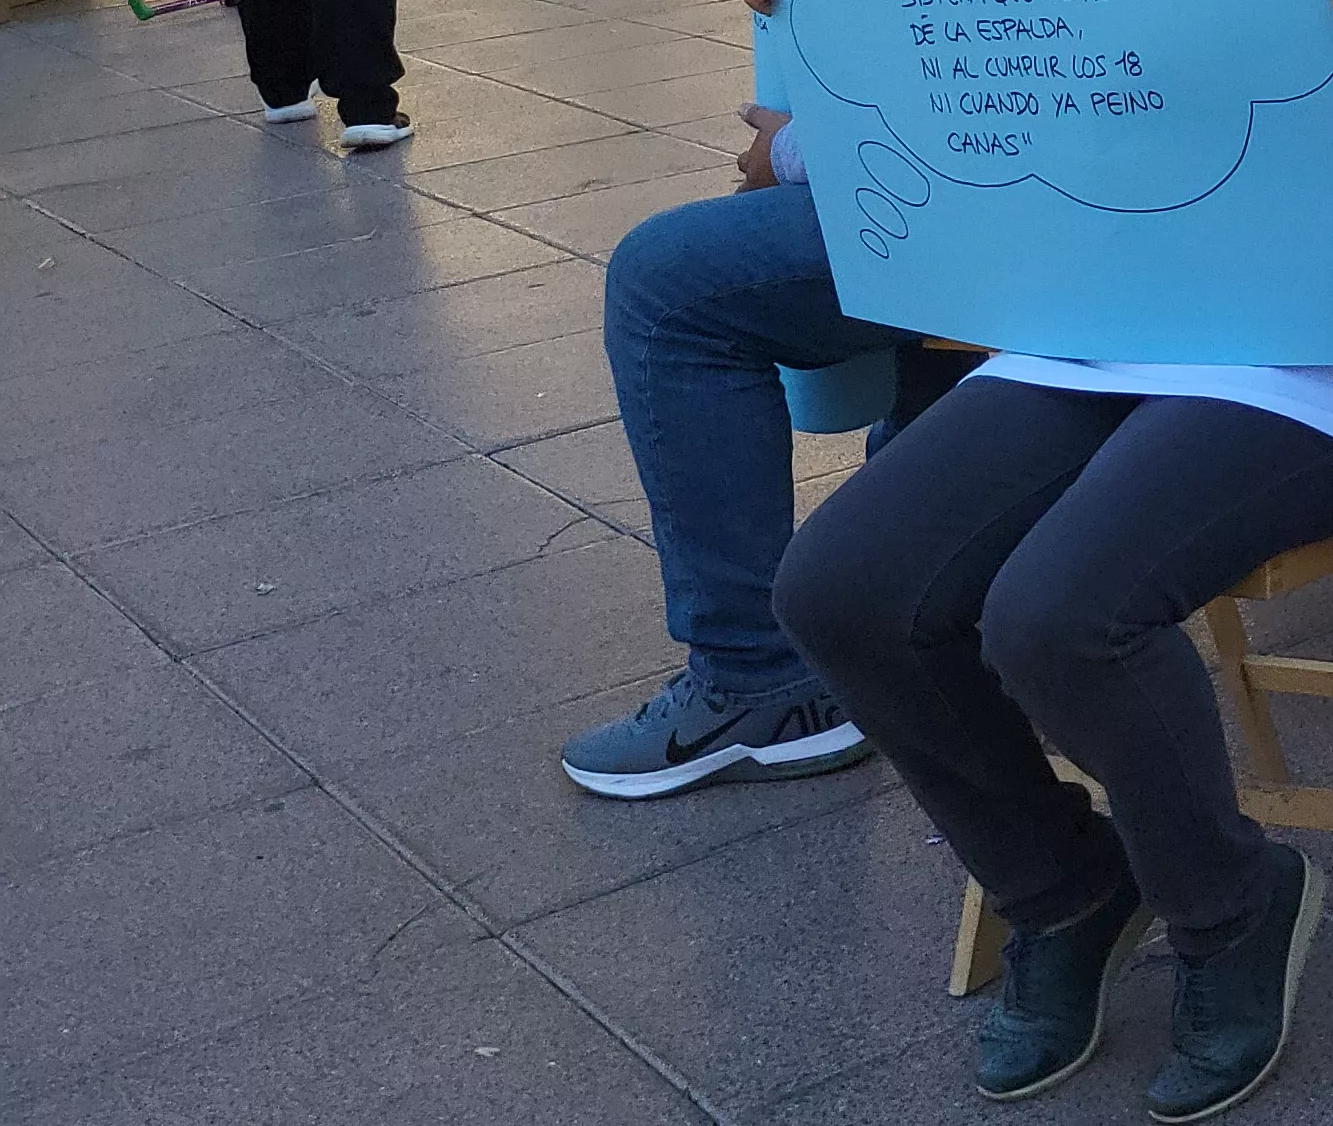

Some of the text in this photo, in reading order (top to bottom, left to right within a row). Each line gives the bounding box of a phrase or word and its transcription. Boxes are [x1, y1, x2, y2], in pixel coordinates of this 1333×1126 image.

[945, 22, 971, 42] LA
[977, 17, 1082, 41] ESPALDA,
[921, 50, 1142, 80] NI AL CUMPLIR LOS 18
[930, 90, 1163, 118] NI CUANDO YA PEINO
